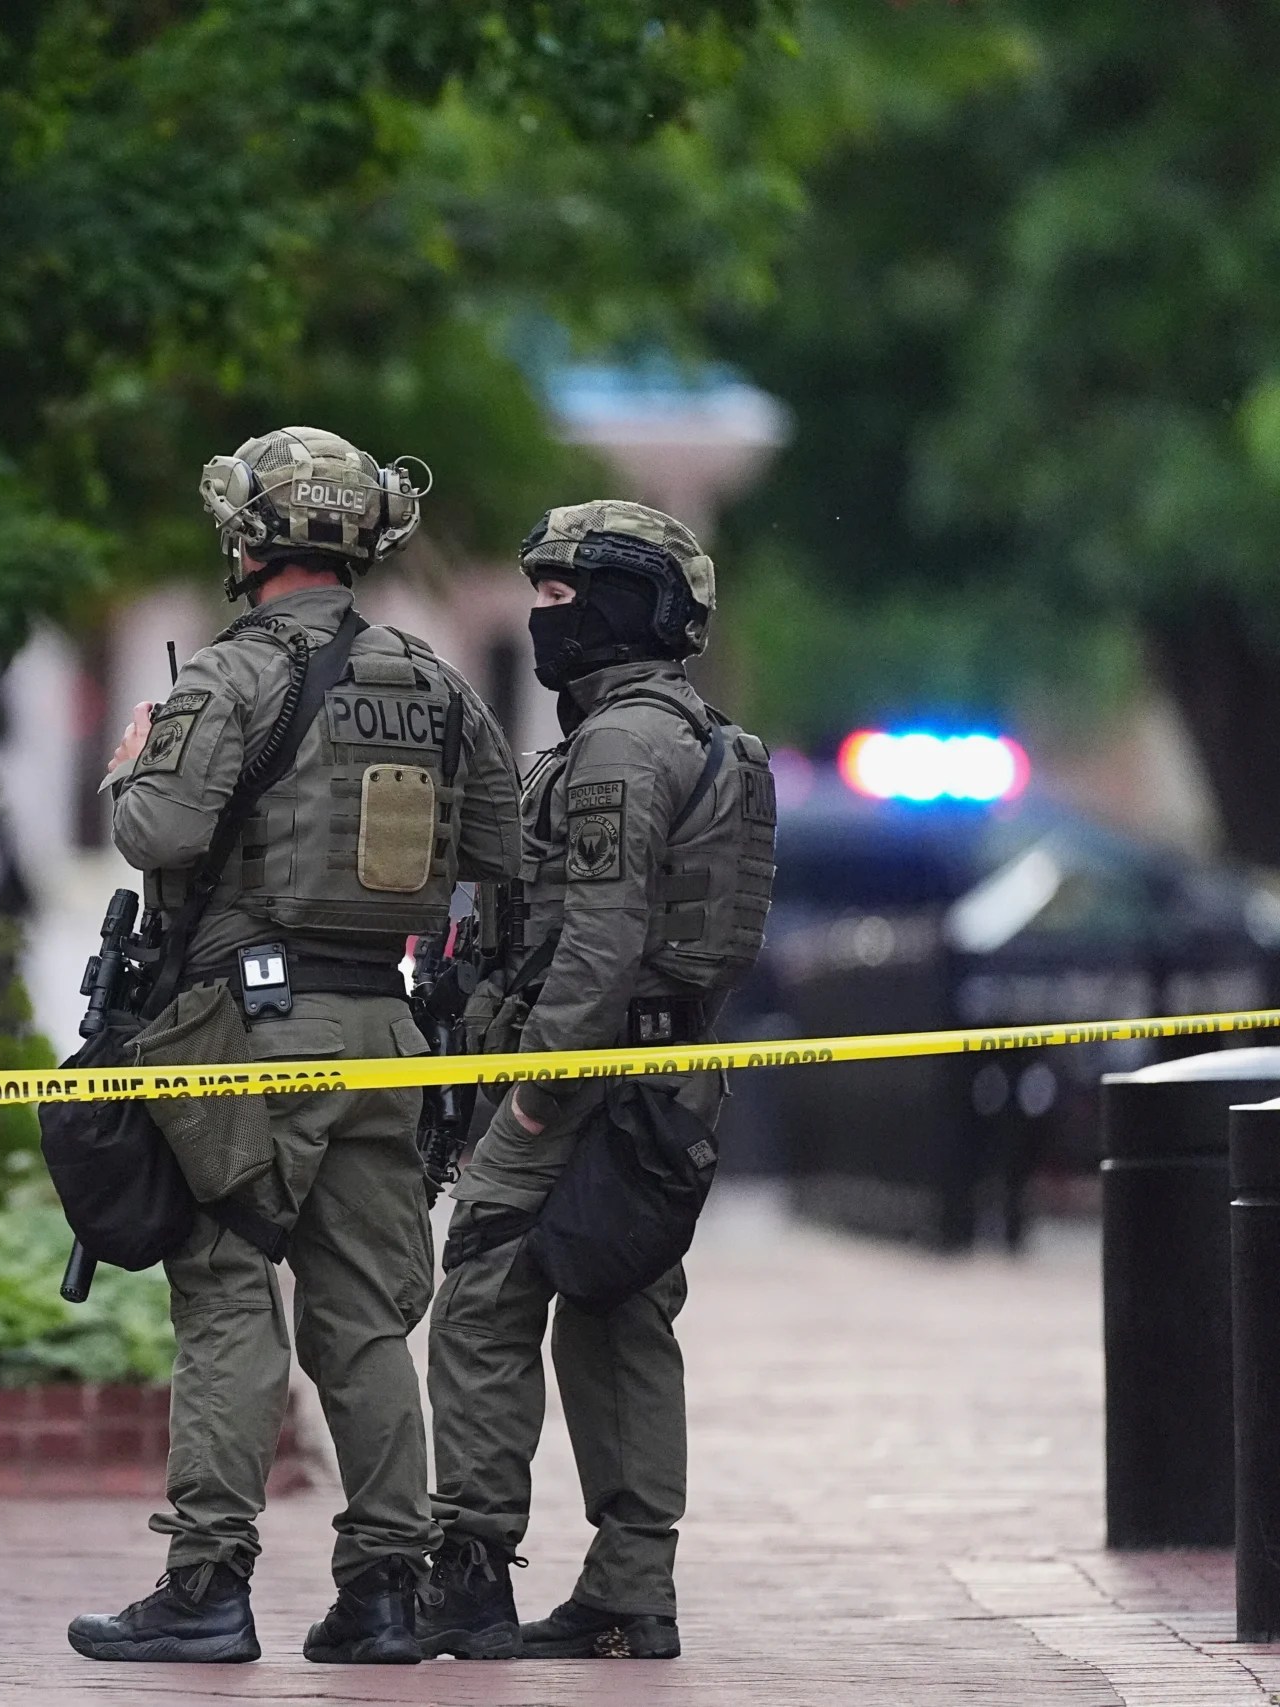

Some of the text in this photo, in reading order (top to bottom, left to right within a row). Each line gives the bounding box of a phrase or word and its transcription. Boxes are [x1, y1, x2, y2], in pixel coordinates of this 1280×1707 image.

[297, 483, 364, 509] POLICE
[331, 696, 446, 745] POLICE
[570, 783, 619, 799] BOULDER
[576, 795, 613, 808] POLICE
